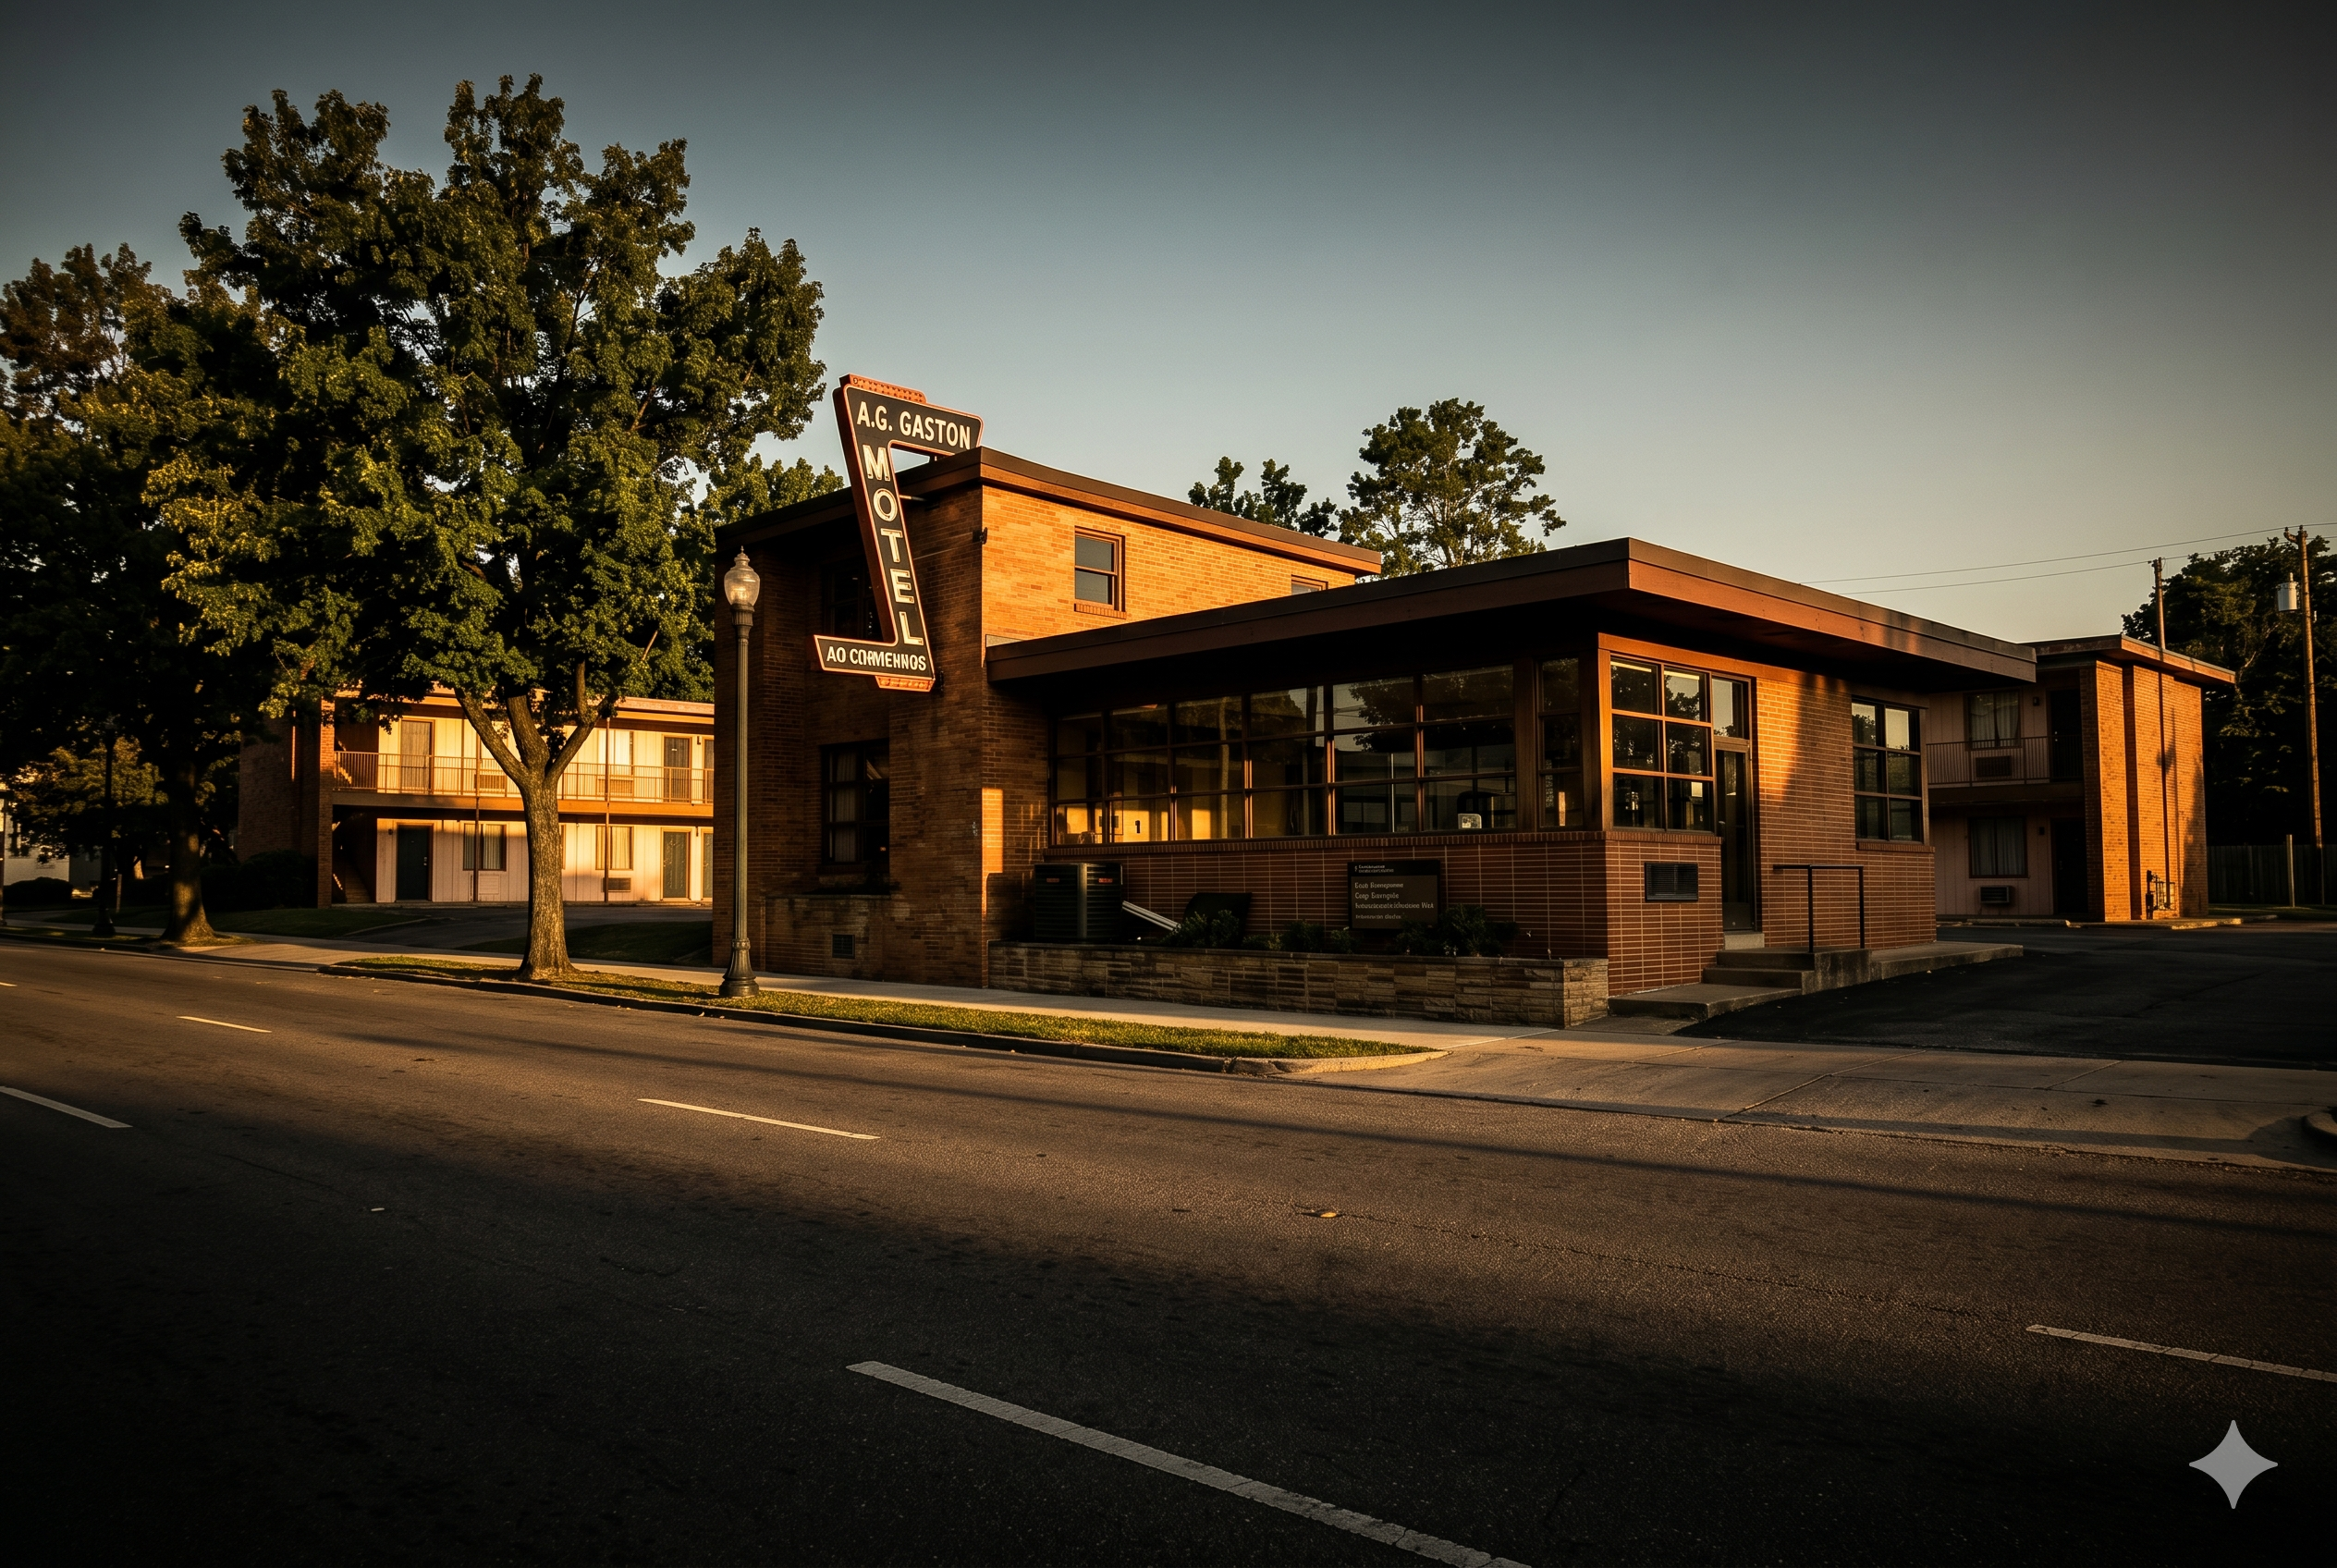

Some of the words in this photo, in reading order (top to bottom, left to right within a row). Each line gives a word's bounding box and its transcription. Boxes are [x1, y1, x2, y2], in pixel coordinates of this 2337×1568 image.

[856, 400, 893, 433] A.G.
[899, 410, 972, 450] GASTON
[862, 444, 924, 645] MOTEL
